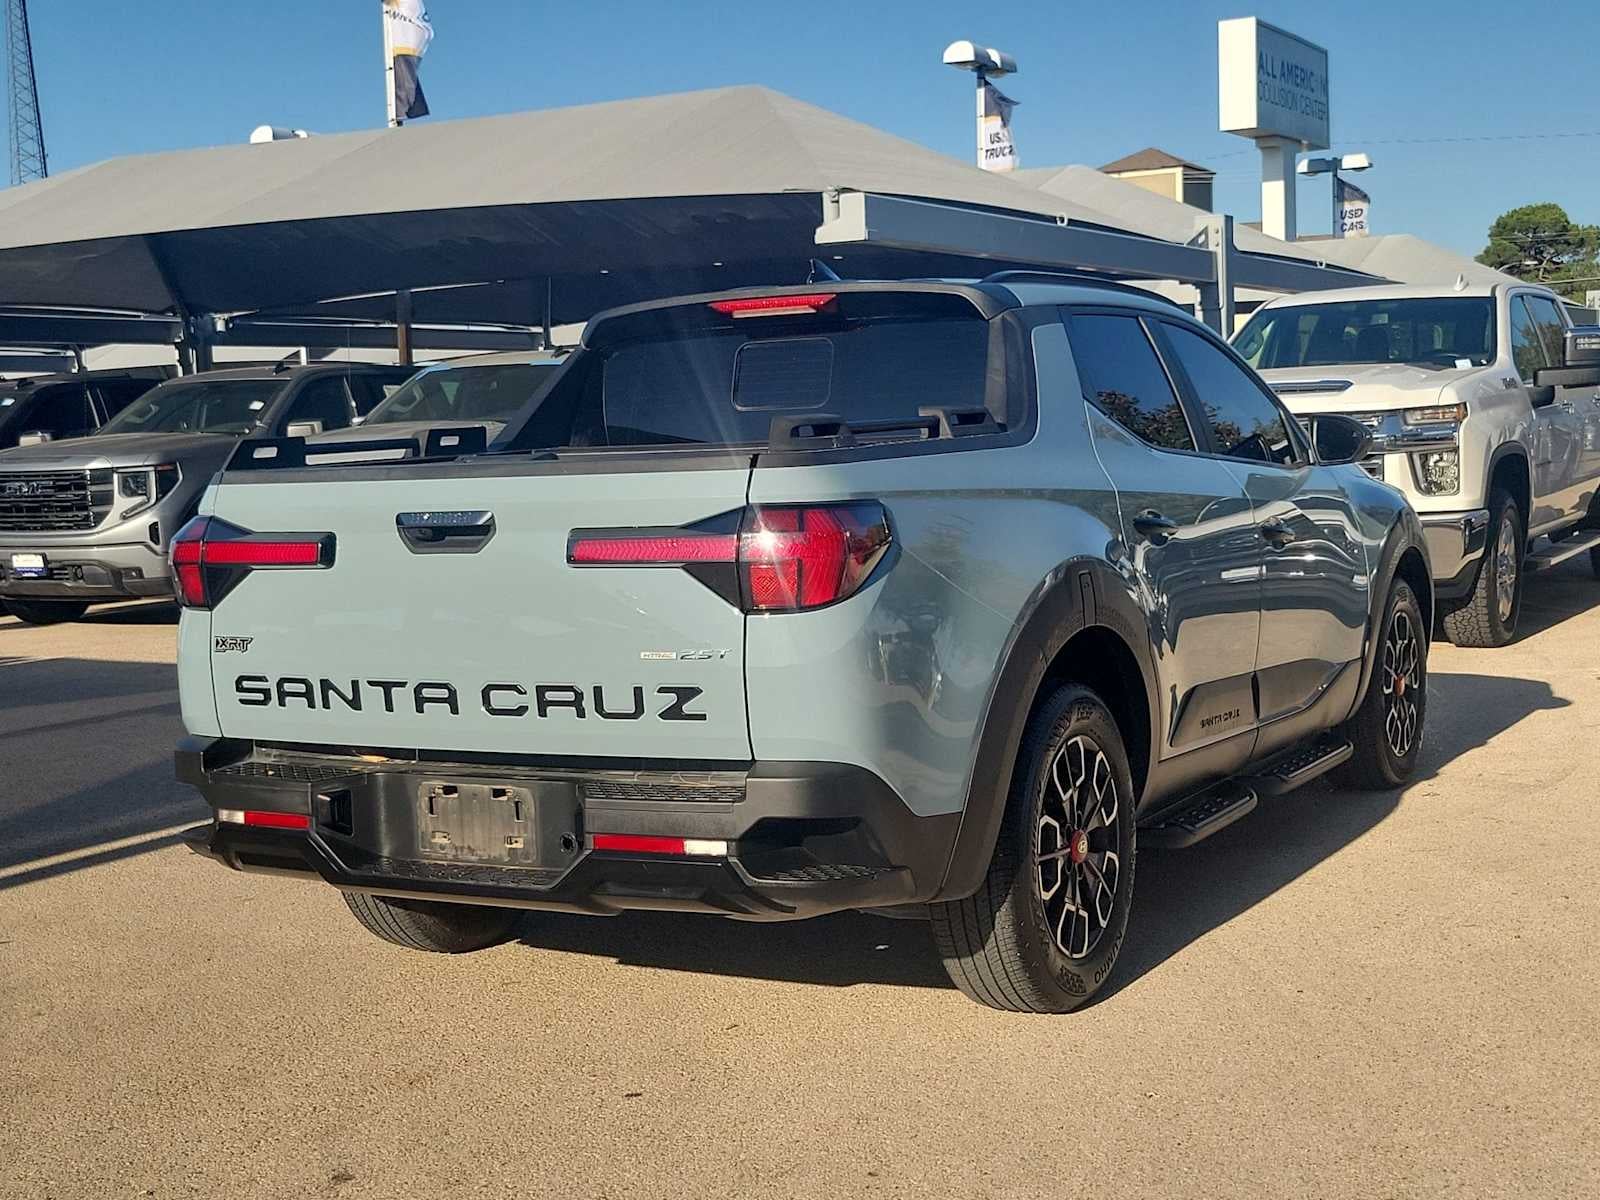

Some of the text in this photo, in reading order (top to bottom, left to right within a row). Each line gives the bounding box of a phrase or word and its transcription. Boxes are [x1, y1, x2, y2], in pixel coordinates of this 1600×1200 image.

[1257, 50, 1327, 98] ALL AMERICN
[1257, 80, 1298, 112] COLLISION
[215, 636, 253, 653] XRT
[235, 675, 707, 721] SANTA CRUZ
